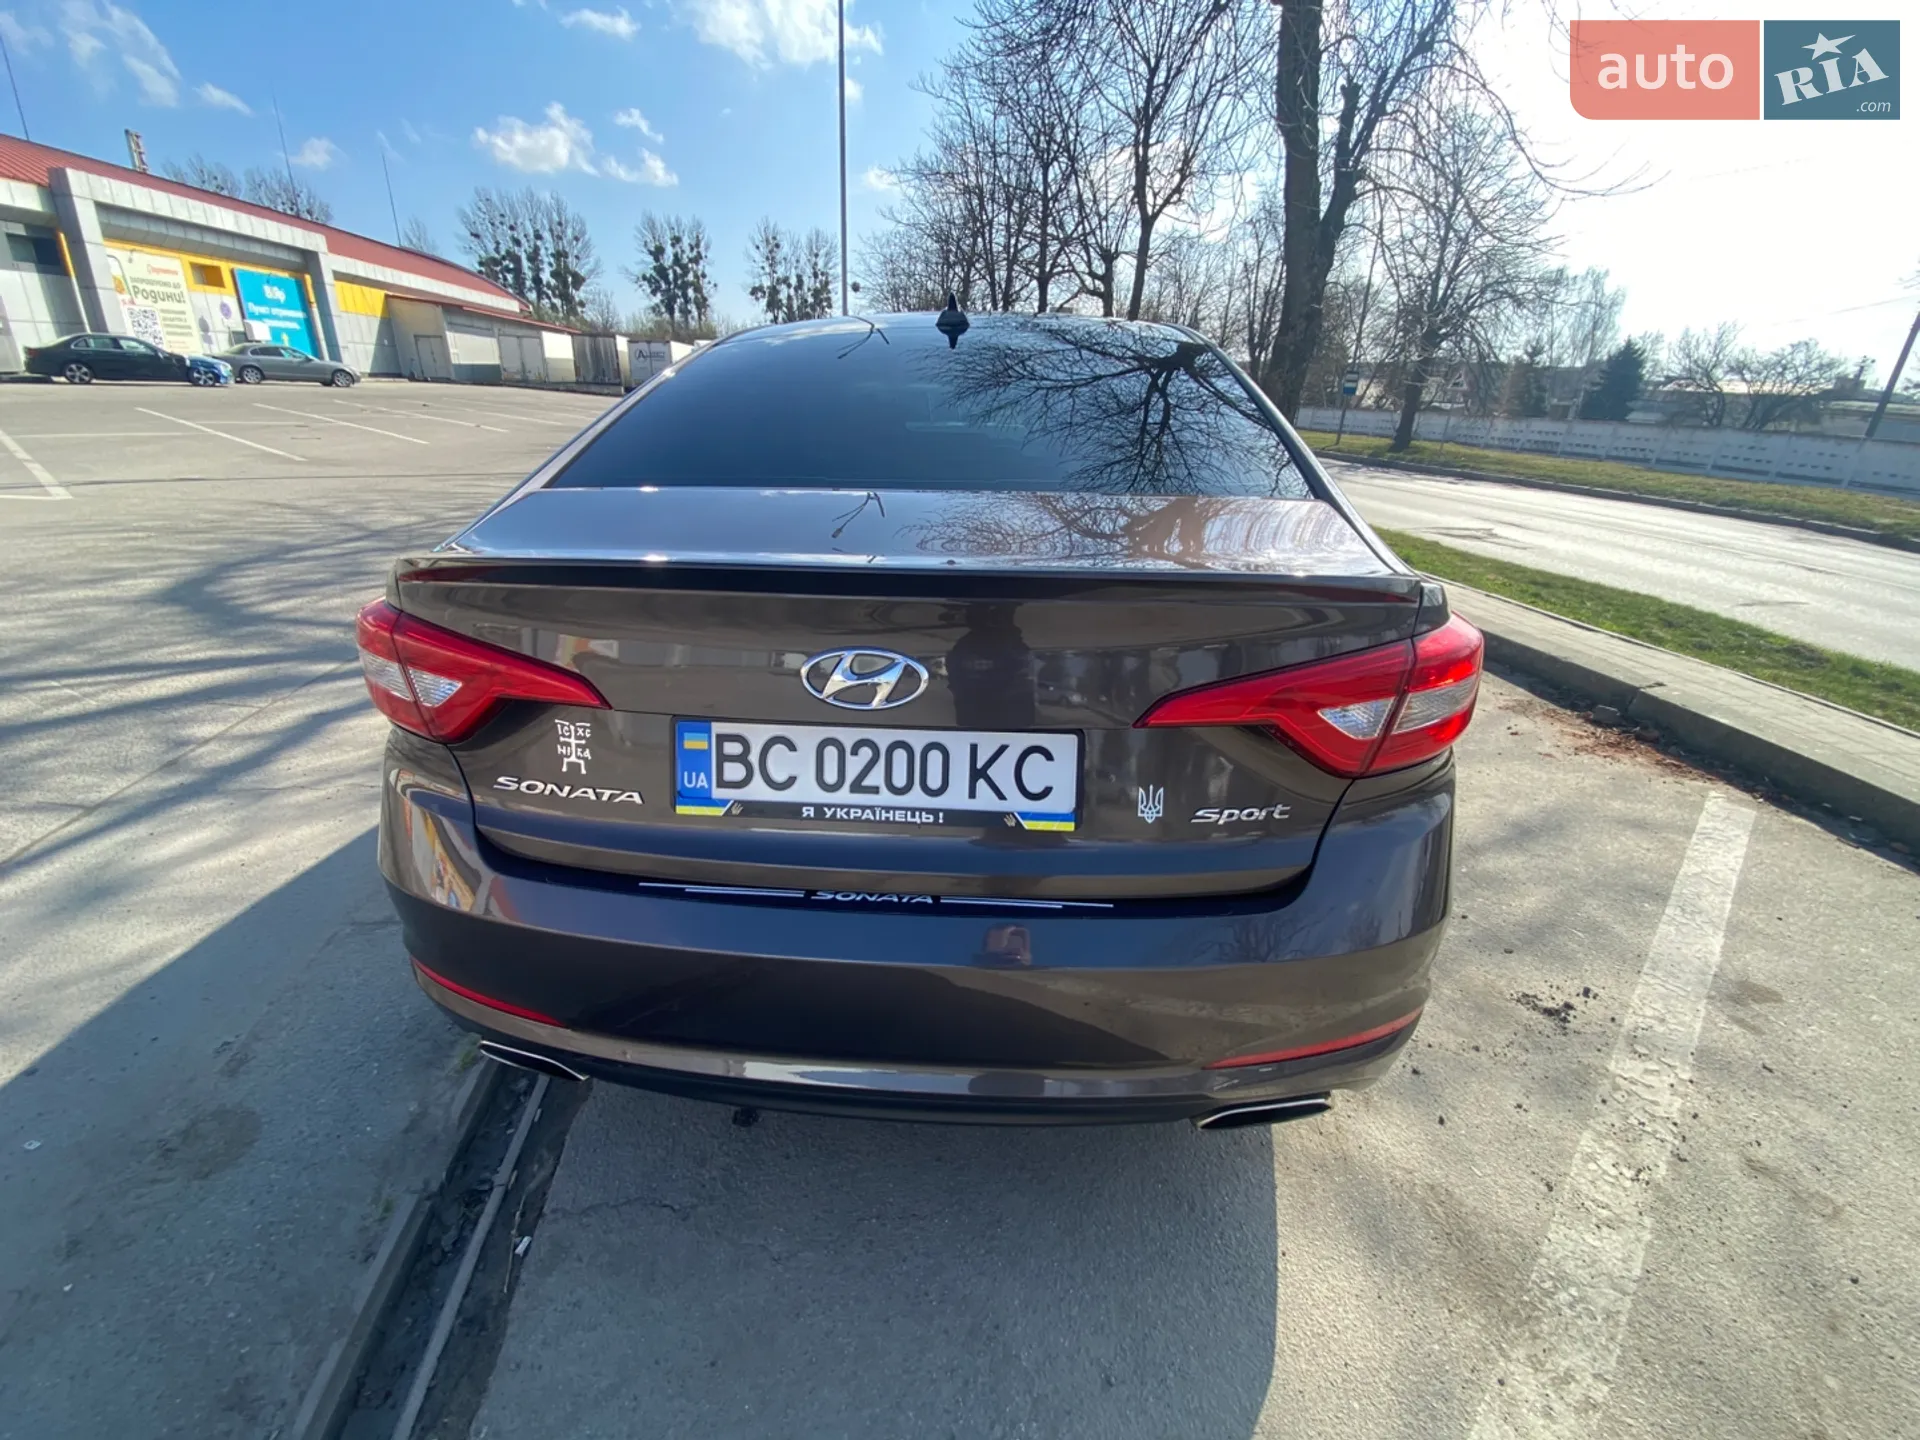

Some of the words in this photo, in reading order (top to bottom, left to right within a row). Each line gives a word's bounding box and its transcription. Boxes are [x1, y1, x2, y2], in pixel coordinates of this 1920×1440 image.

[131, 284, 187, 304] Родини!
[715, 733, 798, 792] BC
[815, 737, 950, 798] 0200
[968, 743, 1055, 802] KC
[683, 771, 709, 789] UA
[493, 776, 645, 805] SONATA
[801, 806, 815, 818] Я
[1190, 804, 1292, 826] Sport
[811, 890, 934, 904] SONATA
